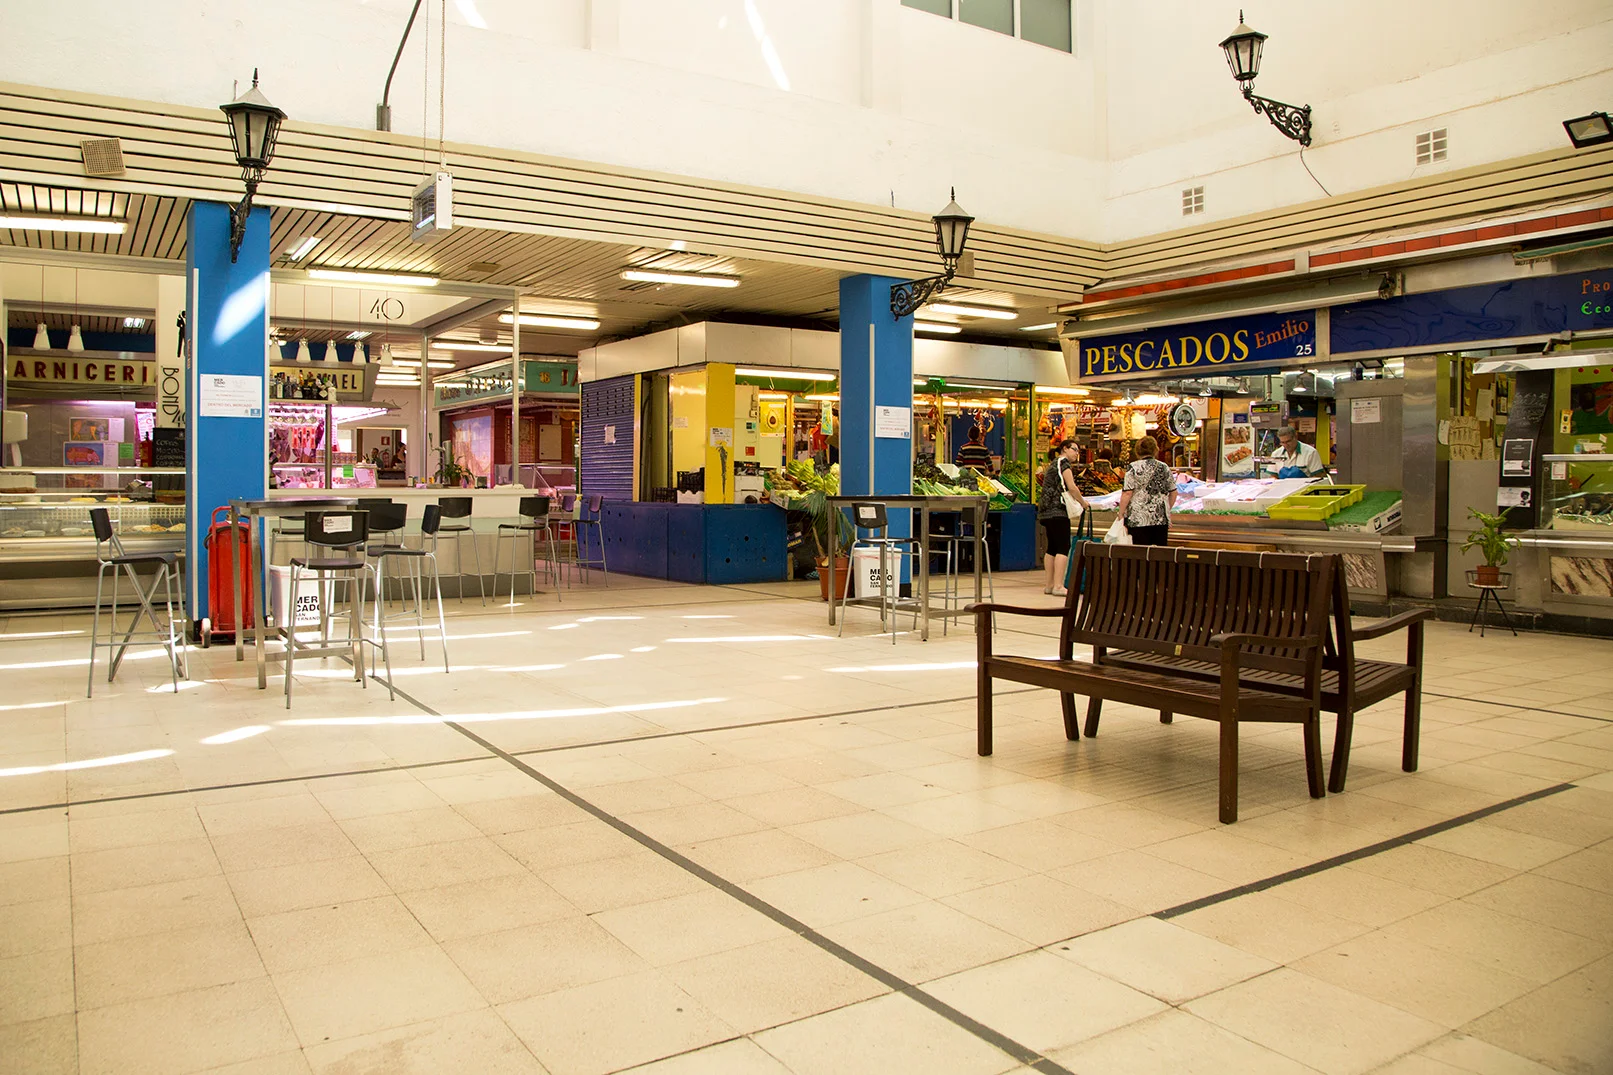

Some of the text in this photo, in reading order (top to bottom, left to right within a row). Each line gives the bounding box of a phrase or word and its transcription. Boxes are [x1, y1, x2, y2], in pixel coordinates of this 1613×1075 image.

[370, 297, 404, 320] 40
[1085, 319, 1309, 376] PESCADOS Emilio
[1296, 344, 1313, 356] 25
[14, 360, 156, 383] ARNICERI
[162, 367, 180, 415] BOND
